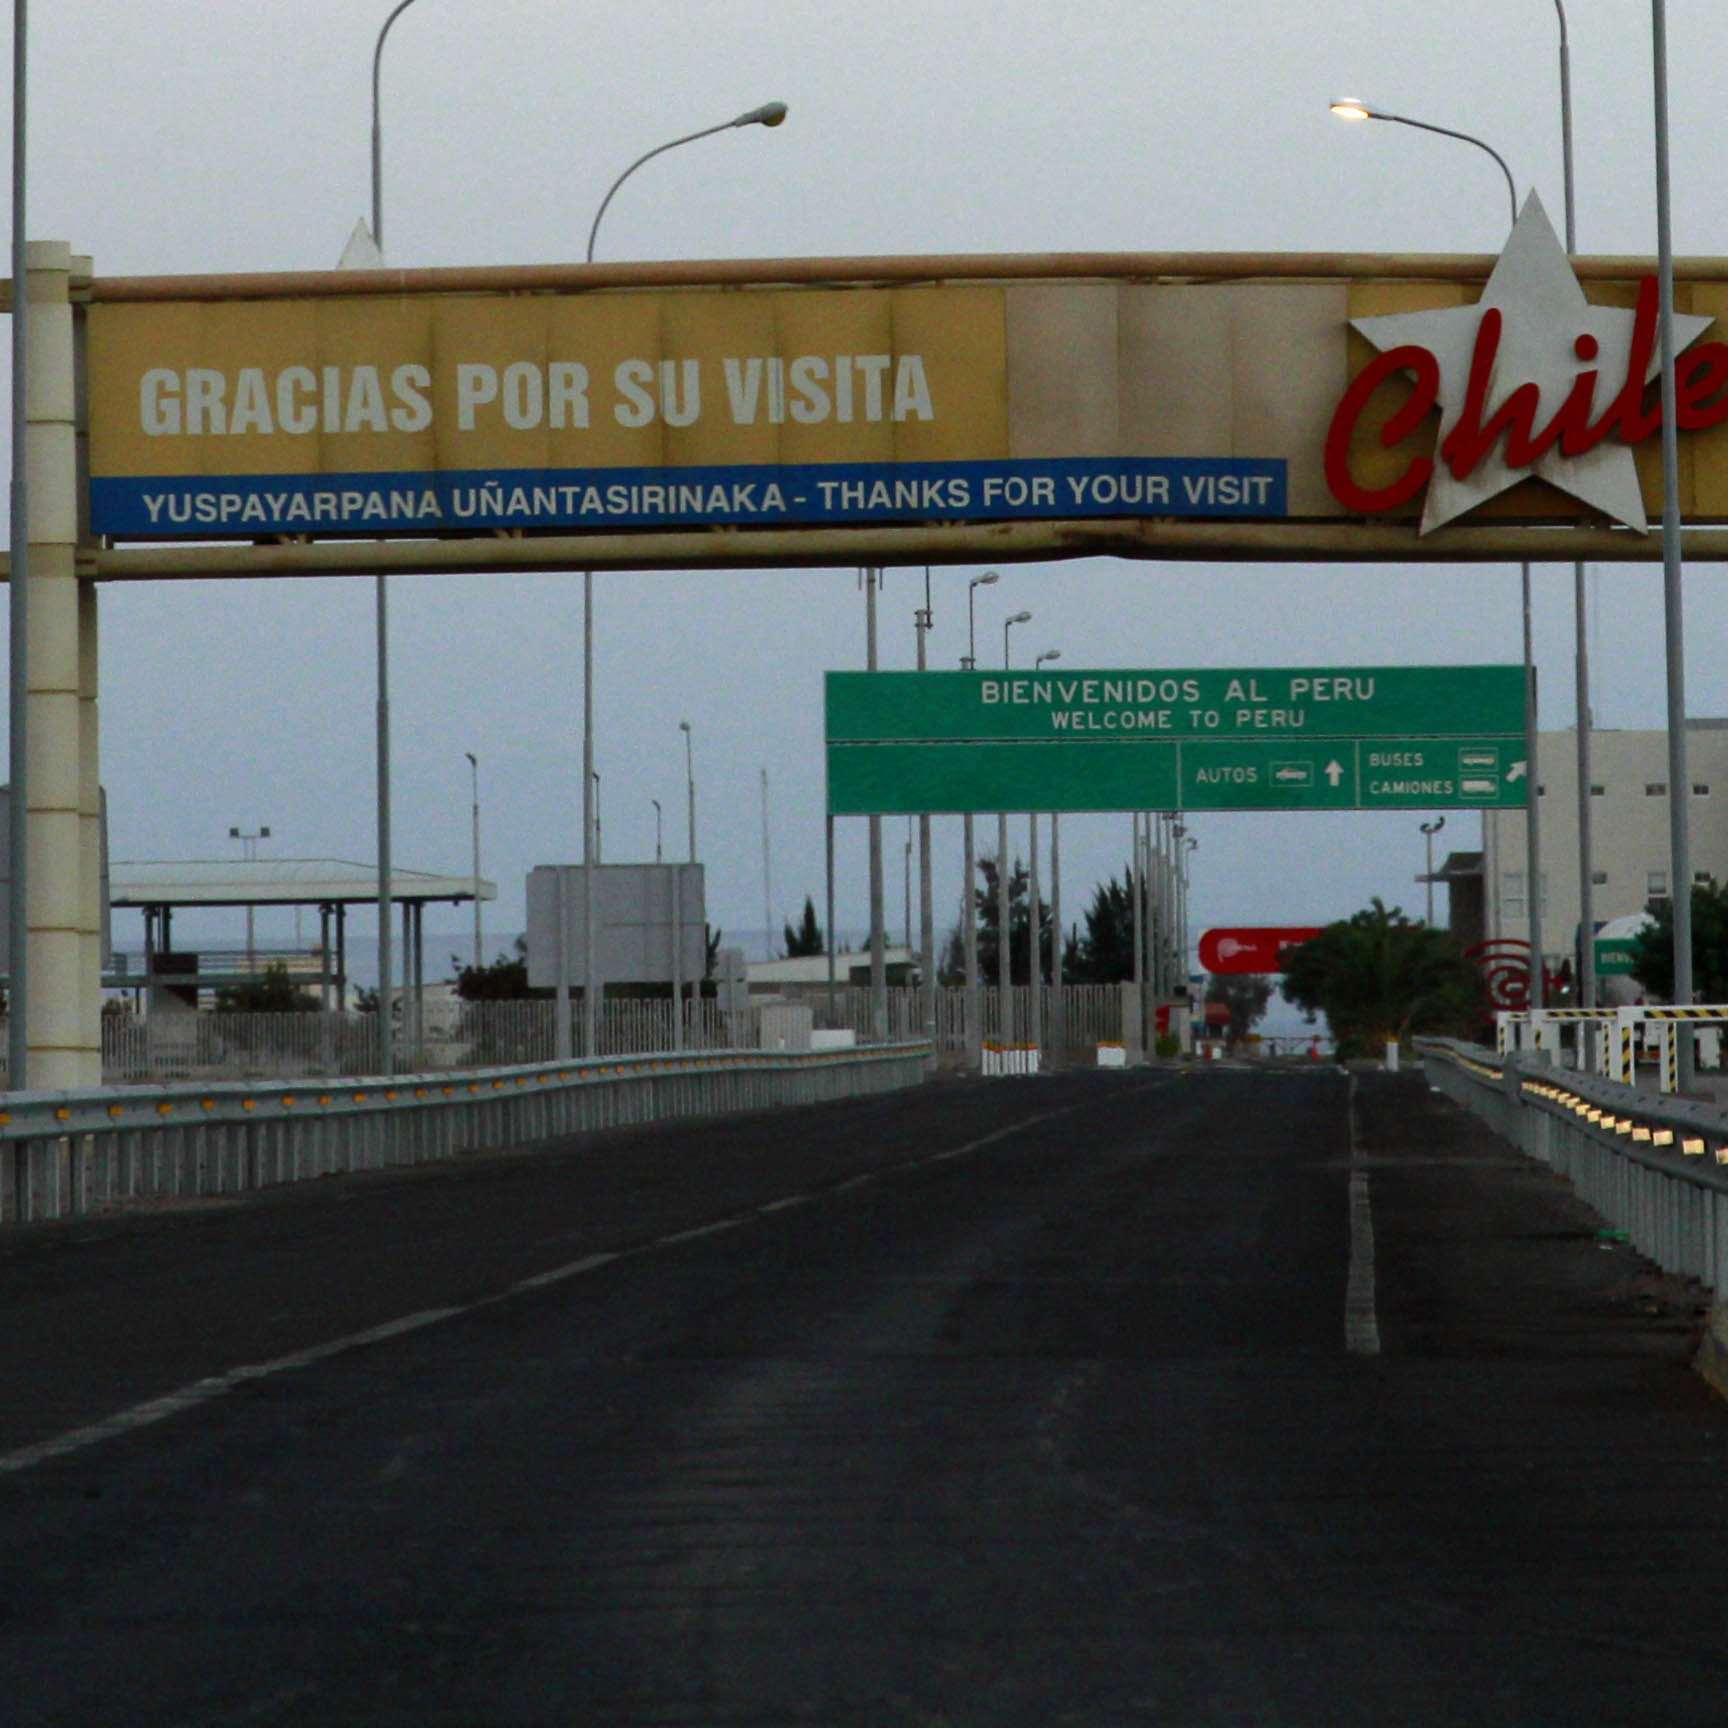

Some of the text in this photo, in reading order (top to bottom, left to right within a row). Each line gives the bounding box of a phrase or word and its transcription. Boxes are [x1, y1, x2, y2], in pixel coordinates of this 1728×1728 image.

[139, 355, 935, 436] GRACIAS POR SU VISITA
[143, 489, 443, 523] YUSPAYARPANA
[453, 481, 787, 518] UÑANTASIRINAKA
[817, 478, 971, 511] THANKS
[983, 477, 1056, 508] FOR
[1067, 475, 1170, 505] YOUR
[1182, 475, 1274, 505] VISIT
[981, 677, 1376, 704] BIENVENIDOS AL PERU
[1050, 709, 1305, 730] WELCOME TO PERU
[1369, 752, 1424, 768] BUSES
[1196, 766, 1259, 785] AUTOS
[1369, 779, 1455, 795] CAMIONES
